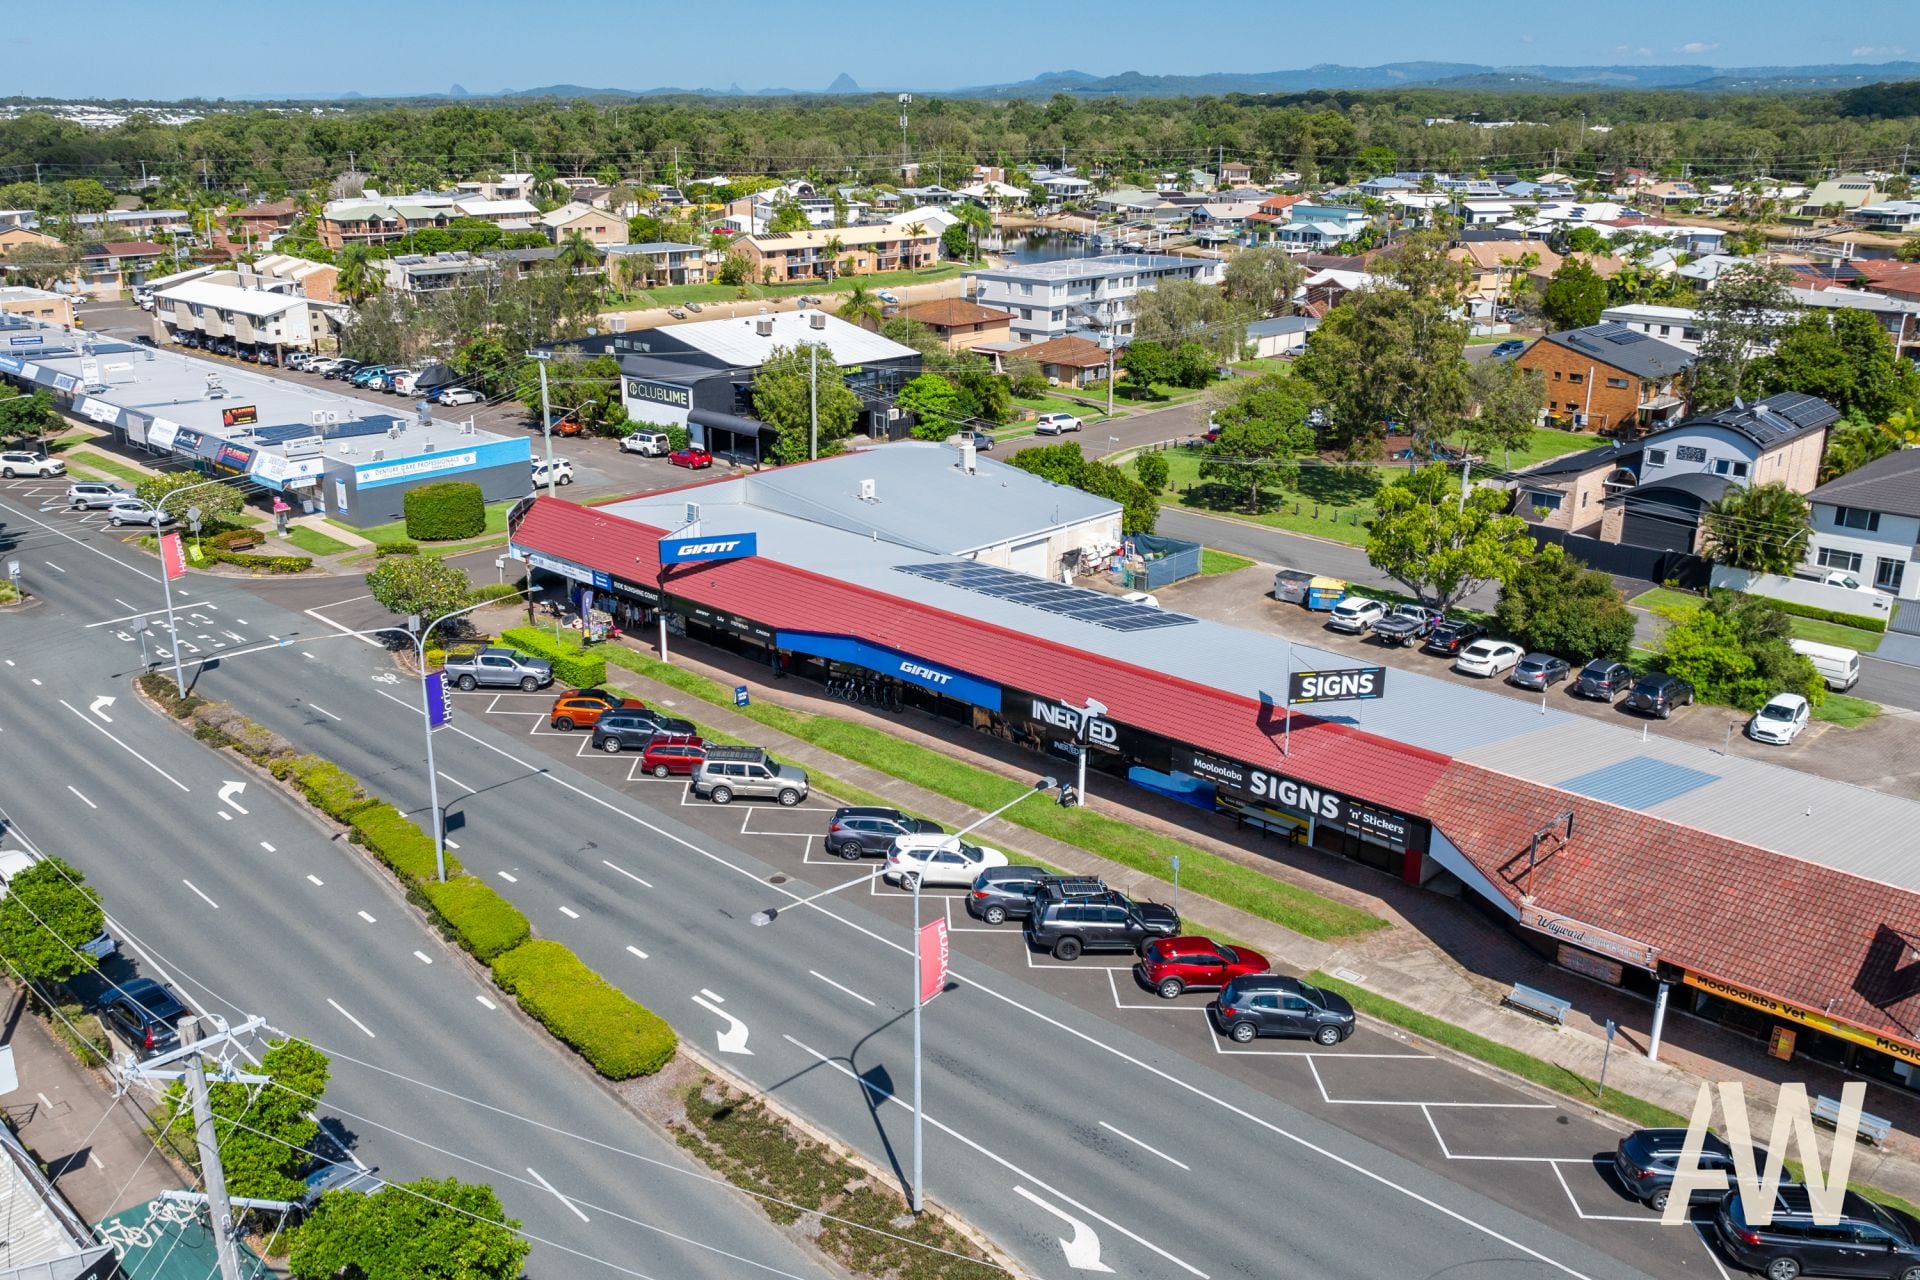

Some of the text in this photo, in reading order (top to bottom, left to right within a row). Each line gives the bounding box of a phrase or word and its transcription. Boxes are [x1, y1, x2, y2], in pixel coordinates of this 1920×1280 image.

[375, 465, 399, 476] DENTURE
[400, 463, 416, 472] CARE
[417, 456, 460, 469] PROFESSIONALS
[174, 535, 187, 573] Horizon
[677, 540, 741, 557] GIANT
[613, 580, 624, 591] RIDE
[624, 584, 645, 597] SUNSHINE
[644, 591, 659, 602] COAST
[899, 661, 953, 685] GIANT
[1301, 673, 1375, 698] SIGNS
[440, 673, 453, 721] Horizon
[1193, 758, 1243, 782] Mooloolaba
[1250, 770, 1341, 819] SIGNS
[1362, 813, 1405, 835] Stickers
[1537, 914, 1585, 942] Wayward
[936, 922, 949, 989] Horizon
[1696, 974, 1777, 1011] Mooloolaba
[1782, 1002, 1807, 1022] Vet
